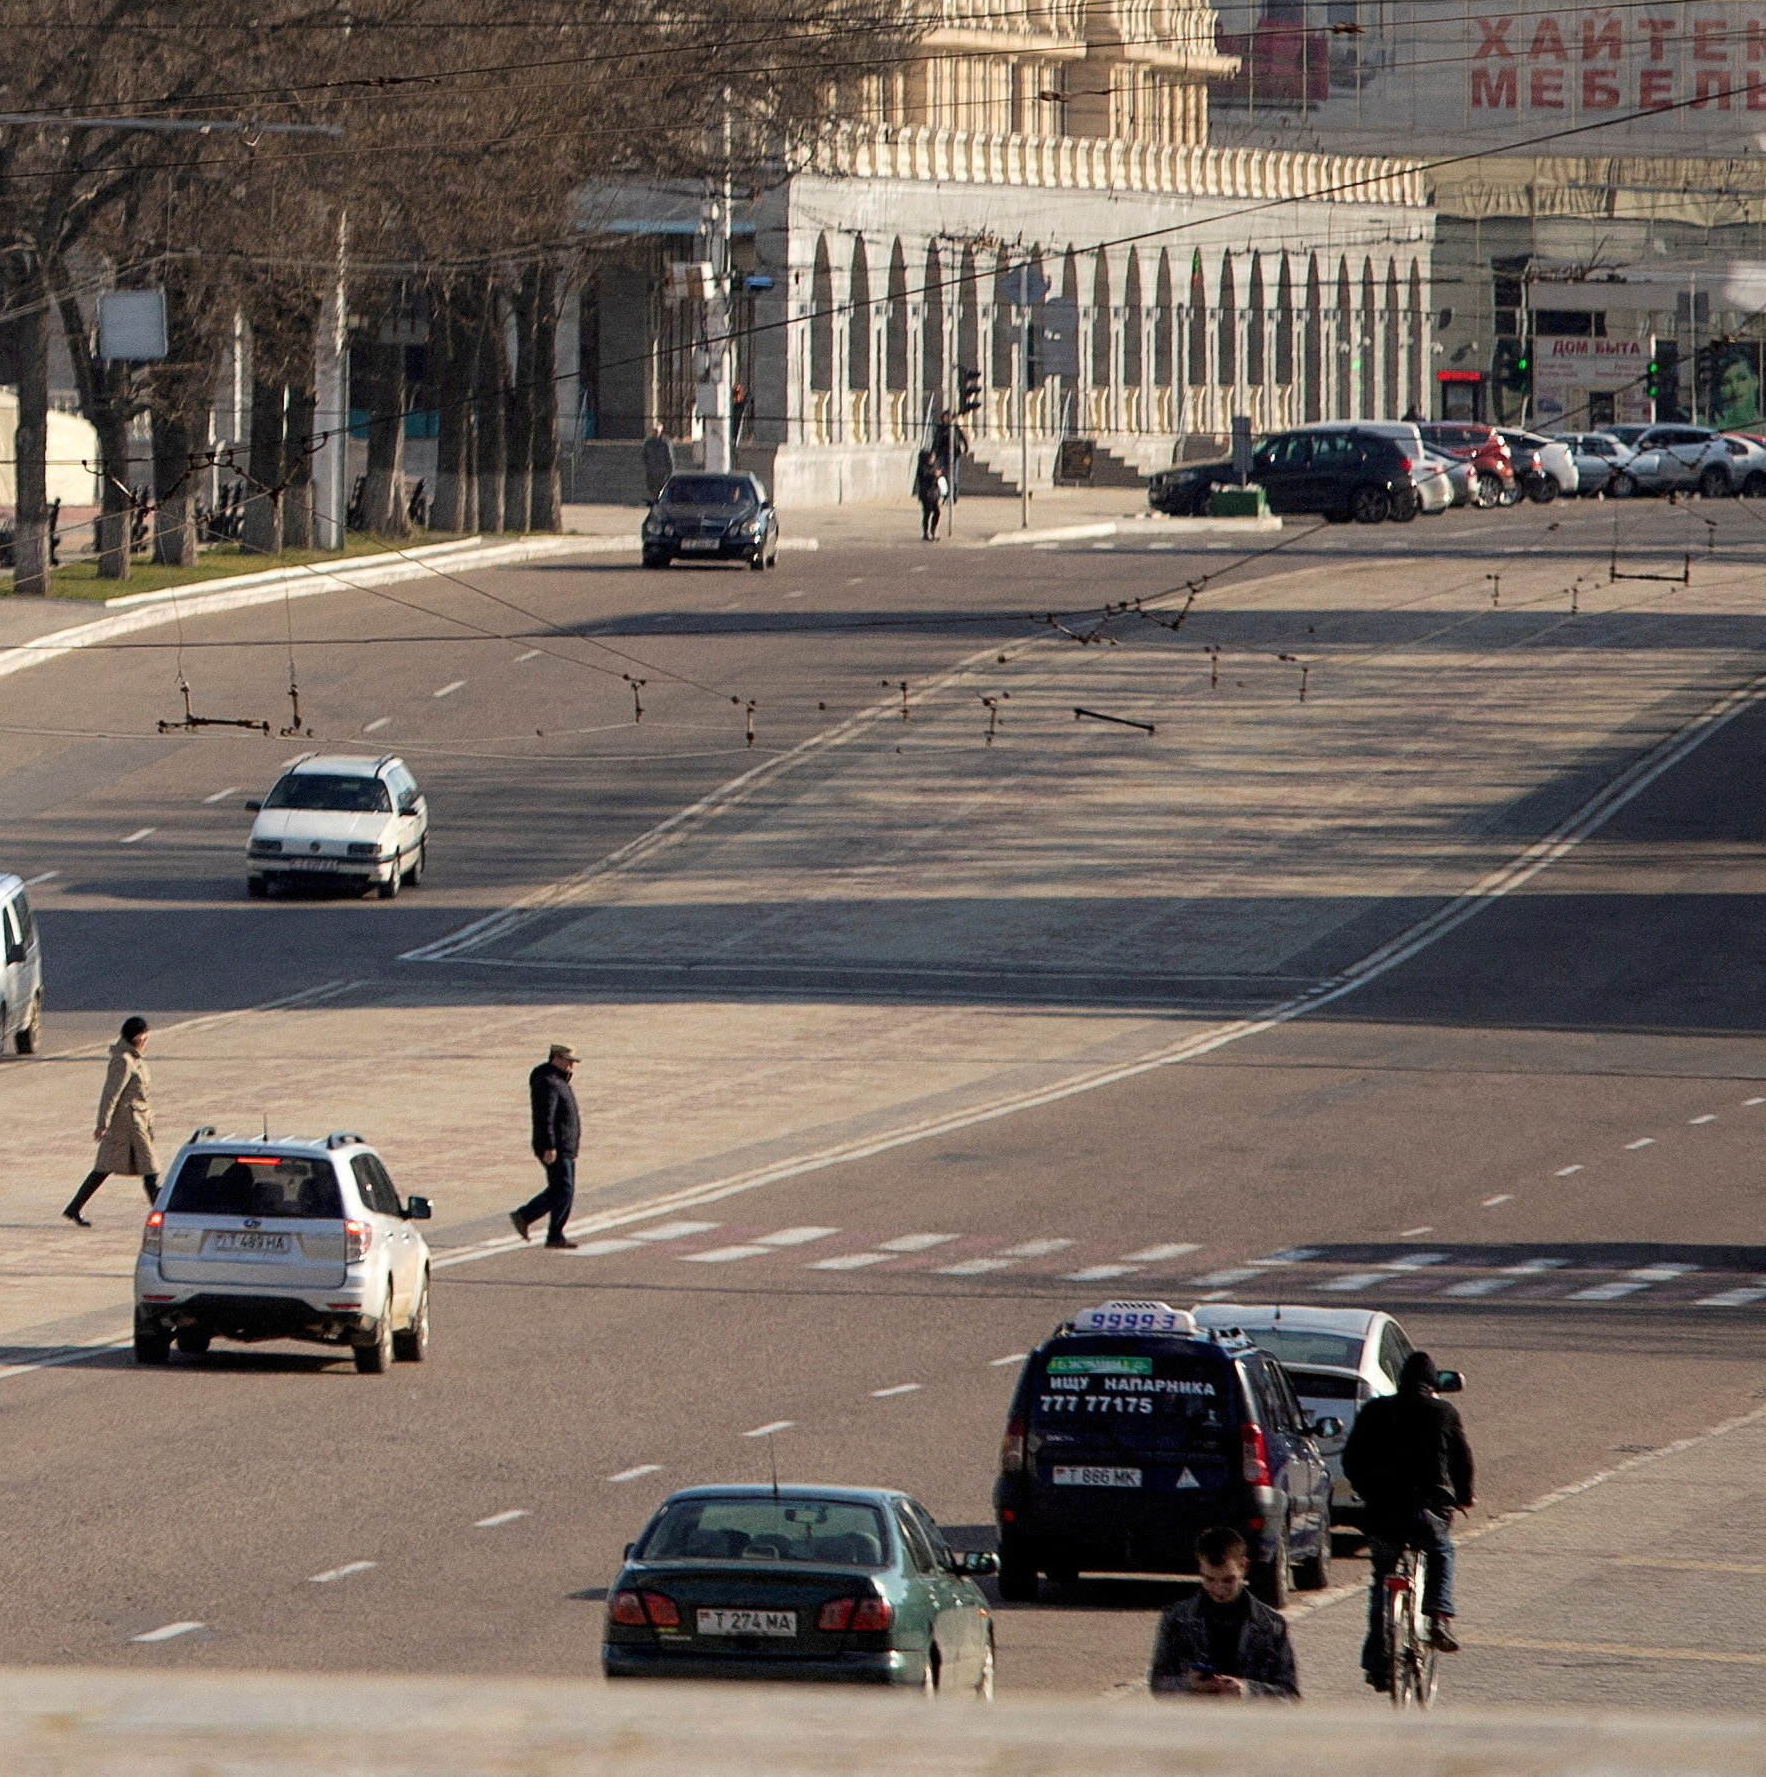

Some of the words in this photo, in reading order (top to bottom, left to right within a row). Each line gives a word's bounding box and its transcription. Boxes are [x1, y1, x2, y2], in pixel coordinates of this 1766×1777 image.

[1552, 340, 1588, 357] ДОМ
[1596, 340, 1641, 356] БЫТА
[1050, 1376, 1090, 1392] ИЩУ
[1104, 1377, 1217, 1396] НАПАРНИКА
[1040, 1395, 1080, 1413] 777
[1084, 1395, 1154, 1414] 77175
[714, 1611, 725, 1629] T
